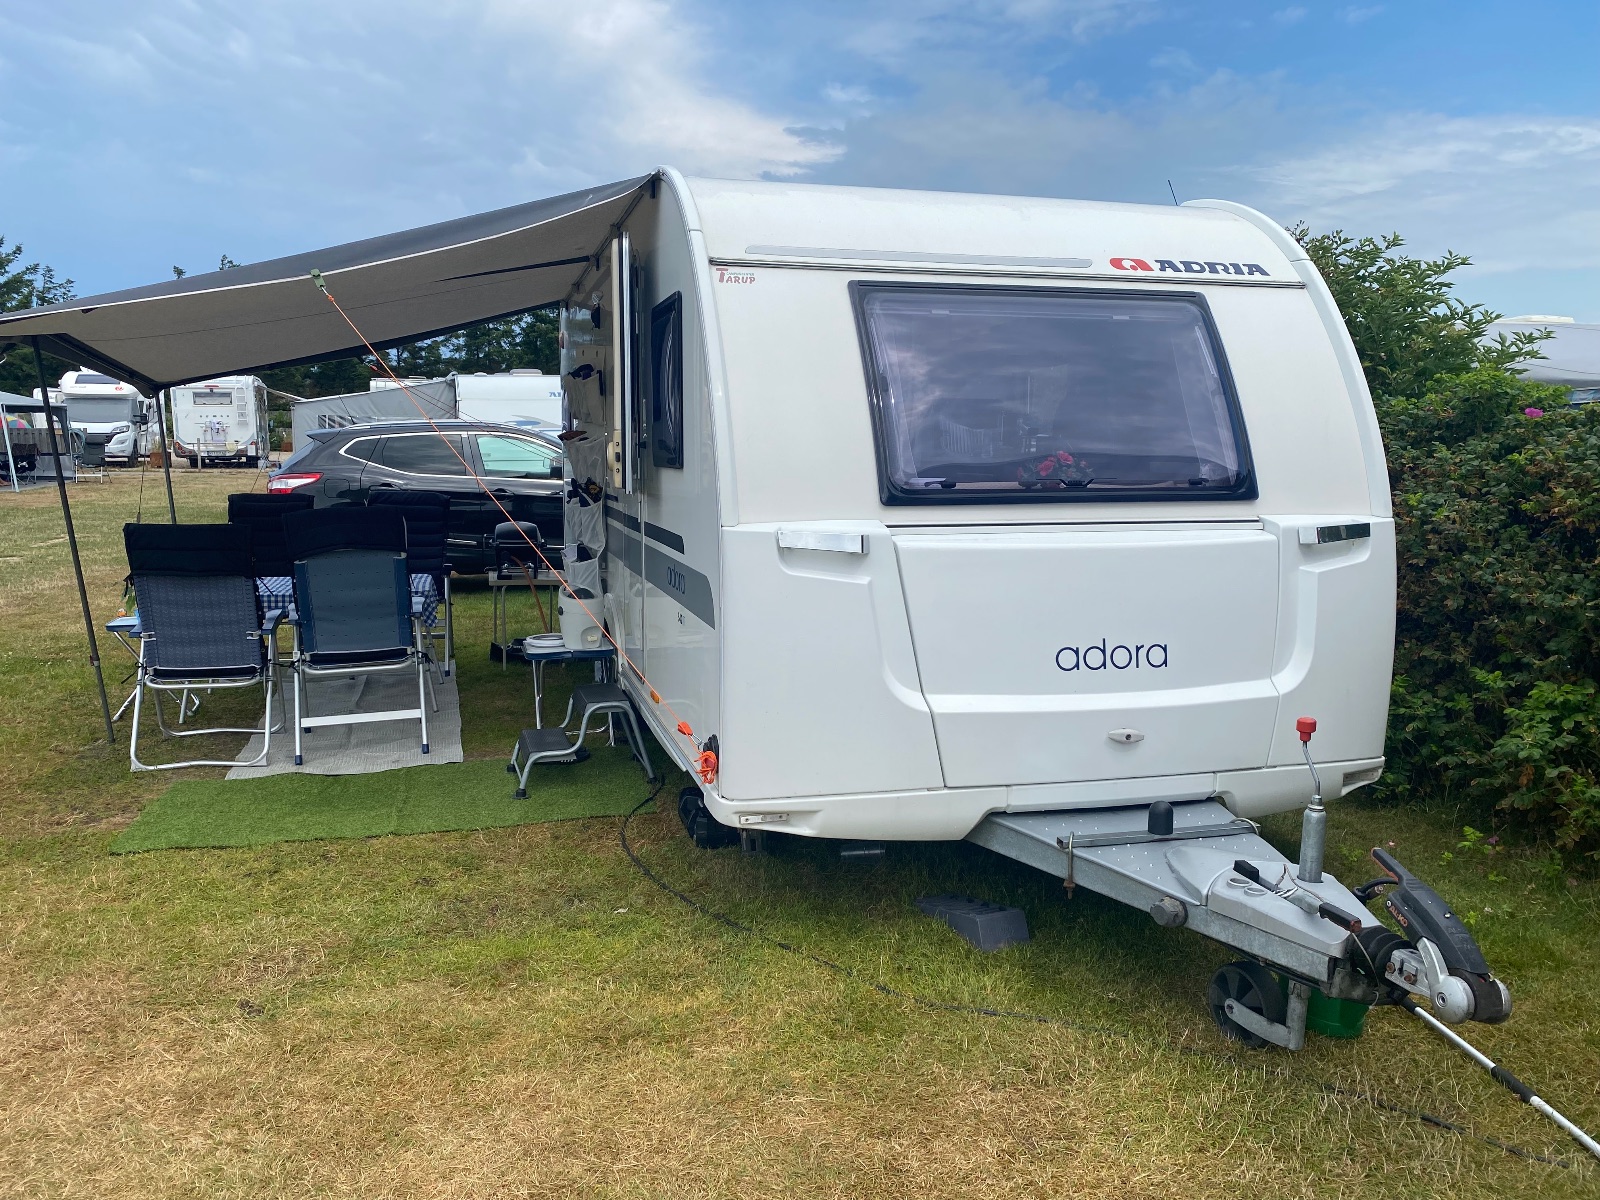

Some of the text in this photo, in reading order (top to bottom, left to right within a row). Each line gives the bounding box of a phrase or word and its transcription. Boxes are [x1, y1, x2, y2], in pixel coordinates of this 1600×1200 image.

[715, 267, 756, 284] TARUP
[1154, 259, 1271, 276] ADRIA
[667, 563, 686, 595] adora
[1055, 637, 1168, 672] adora
